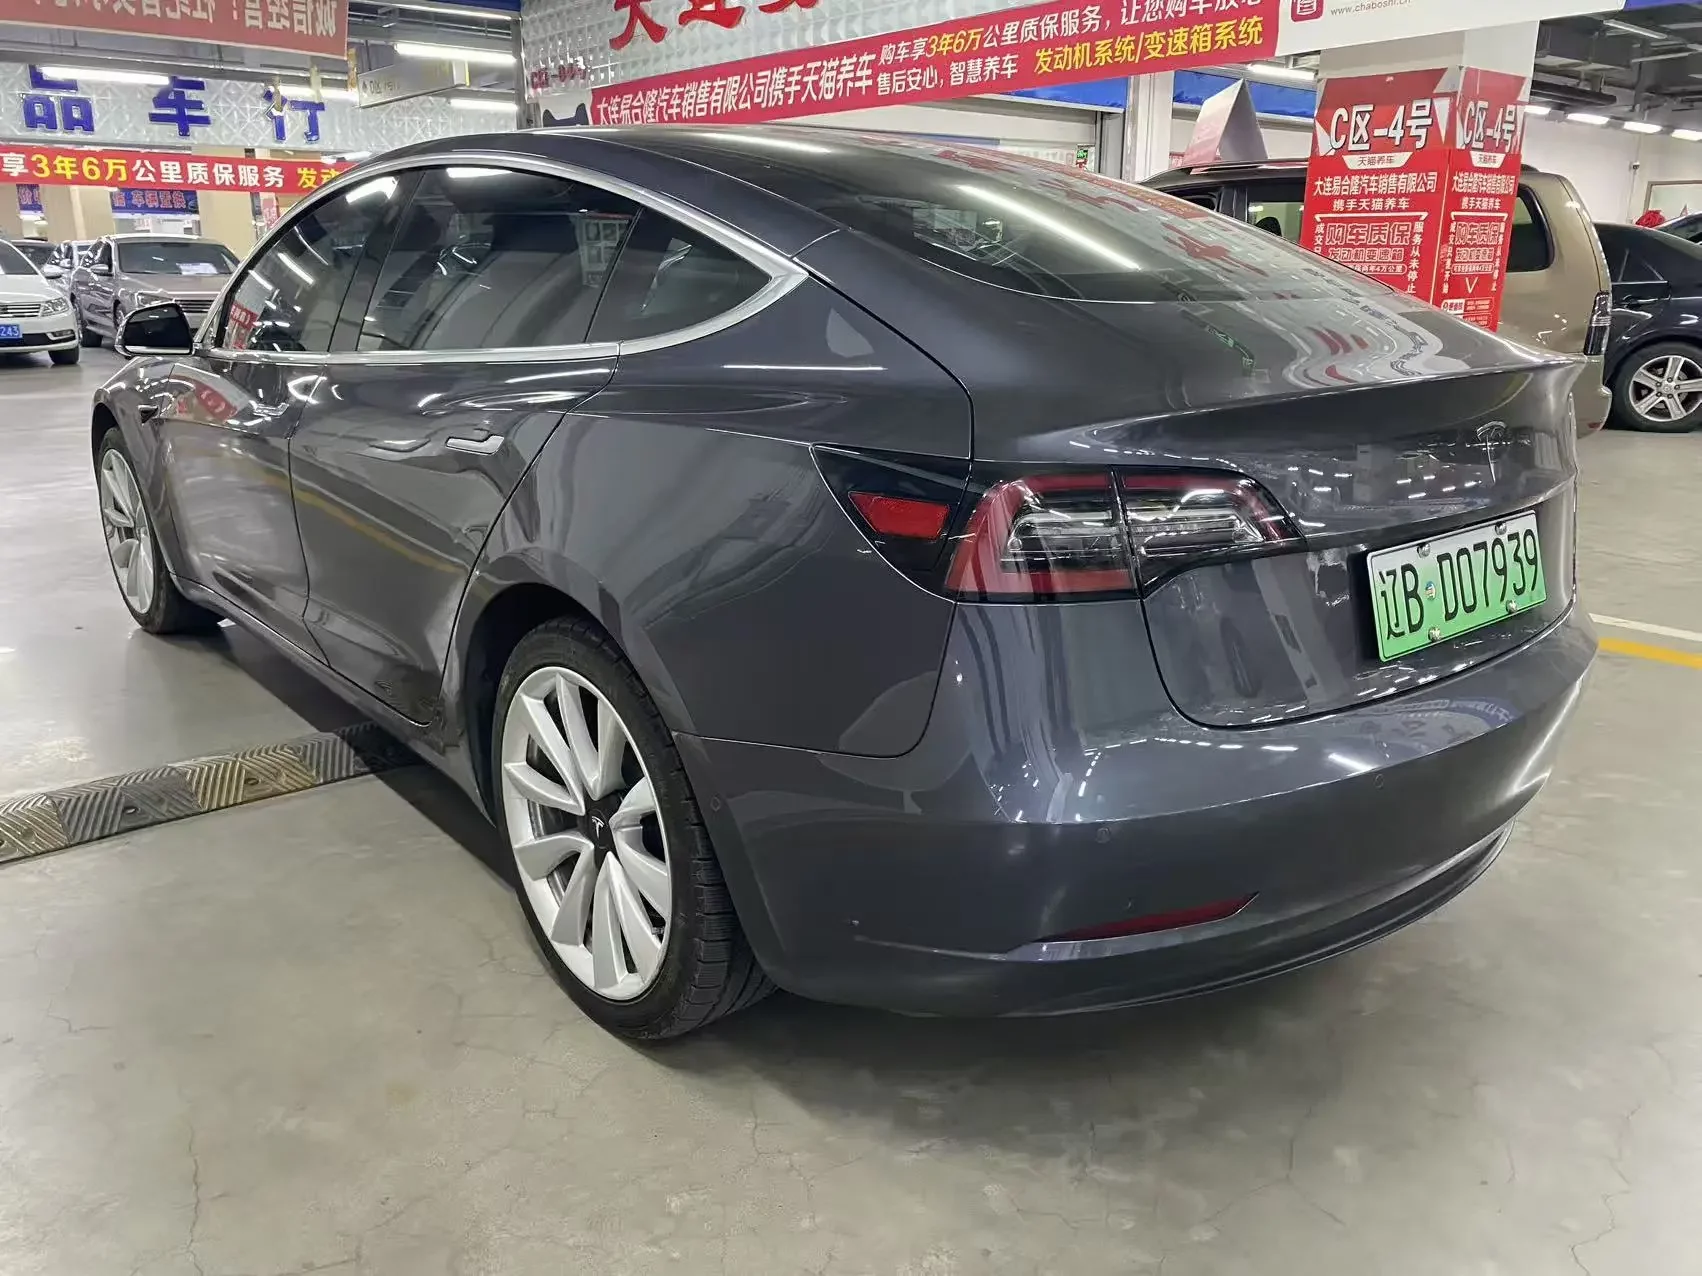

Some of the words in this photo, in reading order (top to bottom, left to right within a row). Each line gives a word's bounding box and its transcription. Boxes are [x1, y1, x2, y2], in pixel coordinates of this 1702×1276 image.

[875, 53, 1019, 96] 售后安心，智慧养车
[1033, 16, 1264, 74] 发动机系统/变速箱系统
[1330, 98, 1433, 151] C区-4号
[1463, 99, 1517, 153] C区-4号
[1, 152, 285, 188] 享3年6万公里质保服务
[1357, 155, 1396, 167] 天猫养车
[1313, 171, 1439, 197] 大连易合隆汽车销售有限公司
[1332, 197, 1411, 212] 携手天猫养车
[1325, 221, 1412, 246] 购车质保
[1406, 221, 1425, 294] 服务从未停止
[1378, 563, 1425, 640] 辽B
[1436, 528, 1540, 622] D07939
